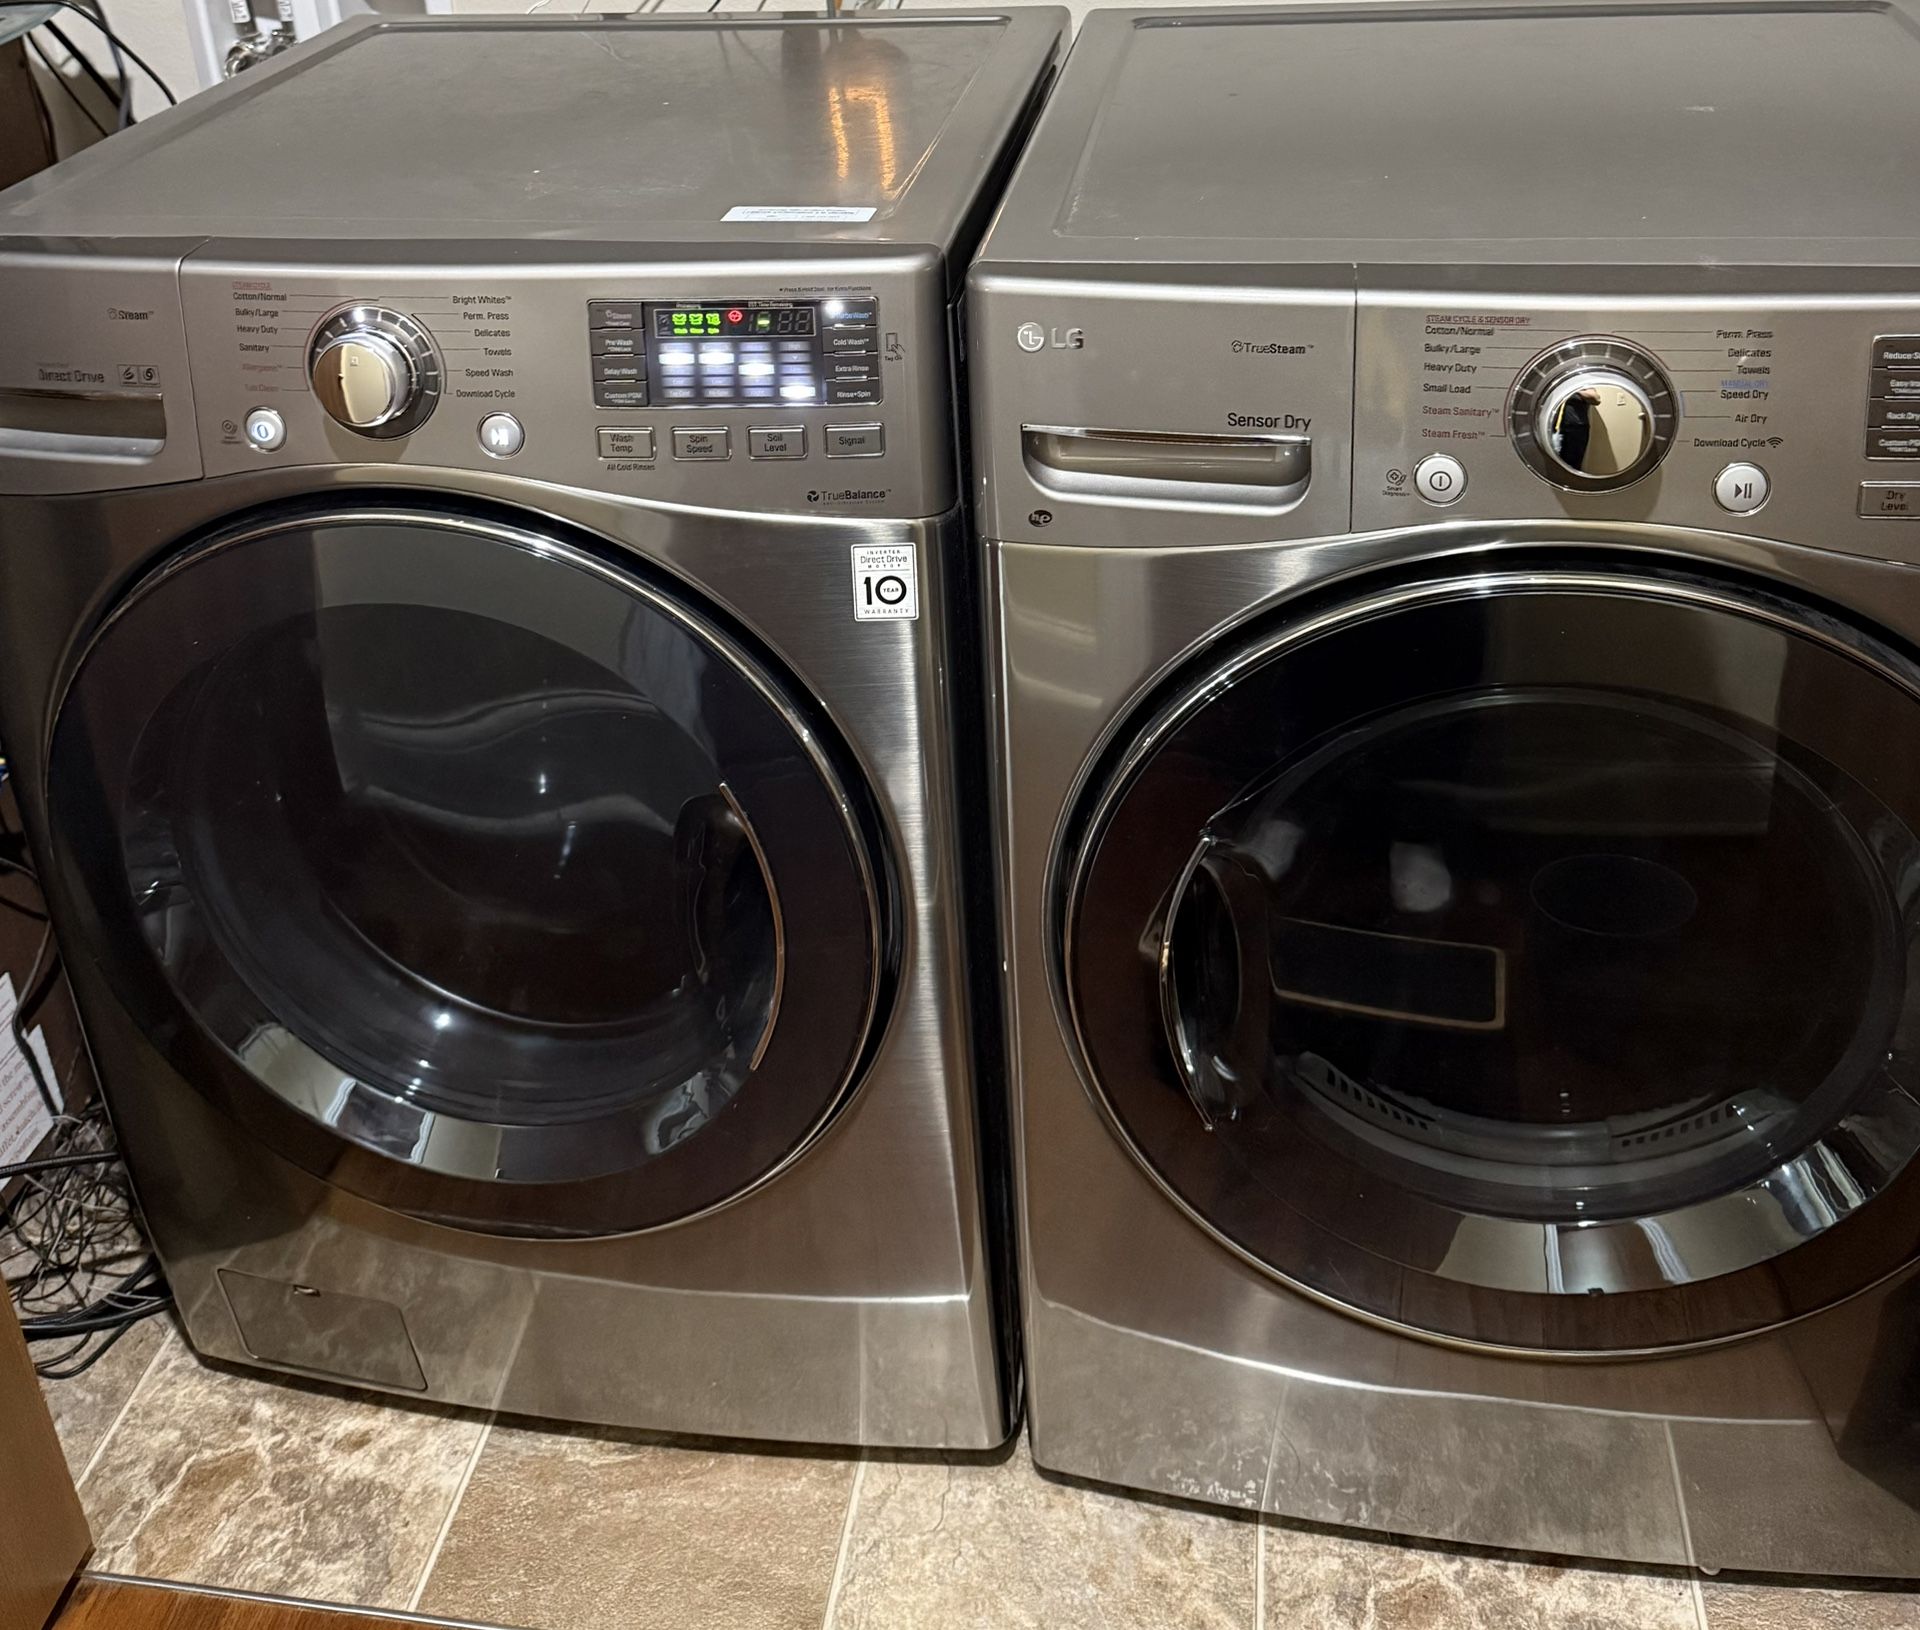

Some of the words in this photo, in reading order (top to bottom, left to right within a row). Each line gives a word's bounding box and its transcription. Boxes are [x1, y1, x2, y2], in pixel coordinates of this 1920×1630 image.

[233, 292, 287, 301] Cotton/Normal
[452, 296, 477, 306] Bright
[235, 308, 279, 318] Bulky/Large
[463, 312, 486, 320] Perm.
[487, 312, 510, 320] Press
[237, 326, 260, 334] Heavy
[261, 326, 278, 335] Duty
[474, 329, 511, 337] Delicates
[1425, 325, 1495, 336] Cotton/Normal
[1051, 327, 1084, 350] LG
[239, 343, 270, 353] Sanitary
[483, 347, 512, 356] Towels
[1424, 343, 1481, 355] Bulky/Large
[1728, 348, 1772, 358] Delicates
[1883, 352, 1912, 360] Reduce
[465, 368, 490, 378] Speed
[491, 369, 514, 377] Wash
[1423, 363, 1453, 373] Heavy
[1454, 363, 1477, 374] Duty
[1737, 365, 1771, 375] Towels
[74, 370, 104, 383] Drive
[1423, 383, 1448, 393] Small
[1449, 385, 1471, 394] Load
[456, 390, 494, 399] Download
[495, 391, 516, 400] Cycle
[1720, 390, 1750, 400] Speed
[1752, 390, 1769, 401] Dry
[1422, 405, 1452, 416] Steam
[1227, 412, 1282, 428] Sensor
[1283, 414, 1312, 432] Dry
[1735, 414, 1749, 423] Air
[1750, 414, 1768, 425] Dry
[610, 433, 634, 443] Wash
[767, 433, 783, 442] Soil
[1422, 428, 1451, 438] Steam
[688, 434, 709, 445] Spin
[838, 436, 866, 447] Signal
[1693, 438, 1739, 448] Download
[1740, 438, 1767, 449] Cycle
[610, 443, 634, 454] Temp
[686, 444, 713, 455] Speed
[764, 443, 788, 452] Level
[616, 463, 632, 471] Cold
[1886, 490, 1906, 500] Dry
[860, 556, 885, 564] Direct
[886, 555, 908, 563] Drive
[863, 575, 907, 606] 10
